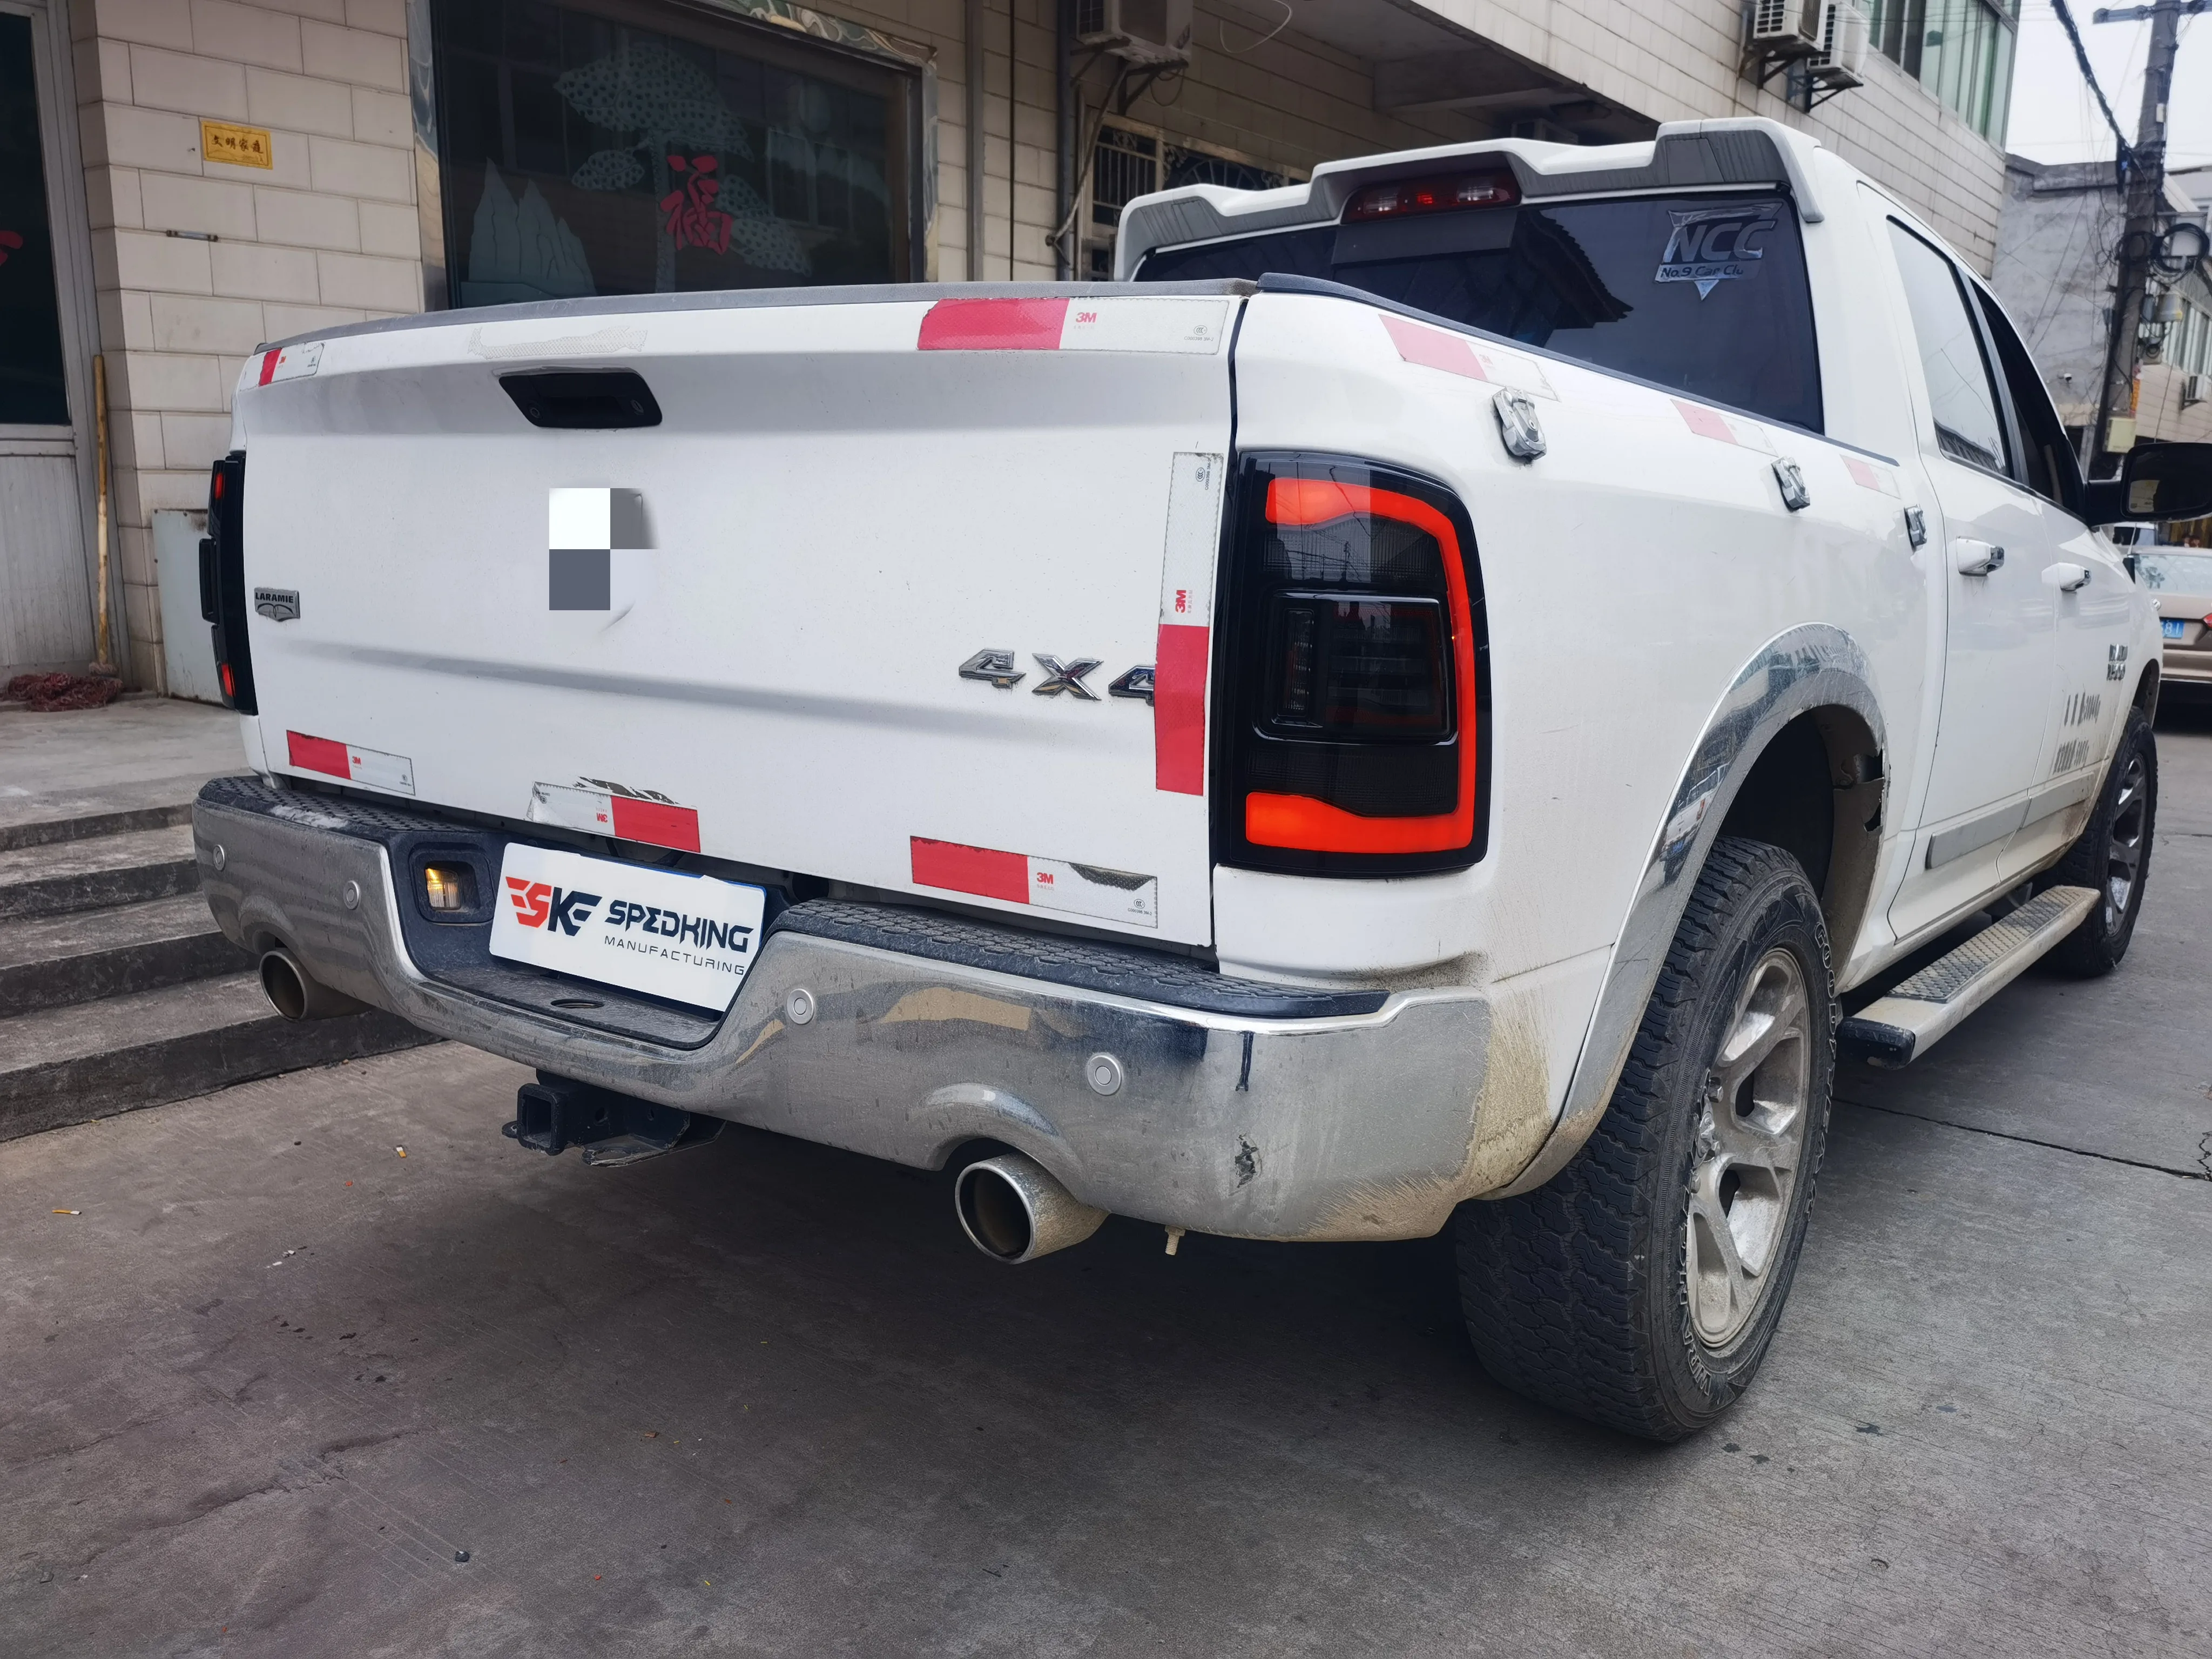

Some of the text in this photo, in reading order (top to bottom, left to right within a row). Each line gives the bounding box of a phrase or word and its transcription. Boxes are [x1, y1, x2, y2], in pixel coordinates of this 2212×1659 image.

[660, 155, 733, 256] 福
[1663, 218, 1778, 263] NCC
[1075, 312, 1097, 323] 3M
[255, 592, 294, 603] LARAMIE
[1175, 590, 1186, 613] 3M
[596, 812, 608, 823] 3M
[1036, 872, 1054, 885] 3M
[604, 935, 745, 975] MANUFACTURING
